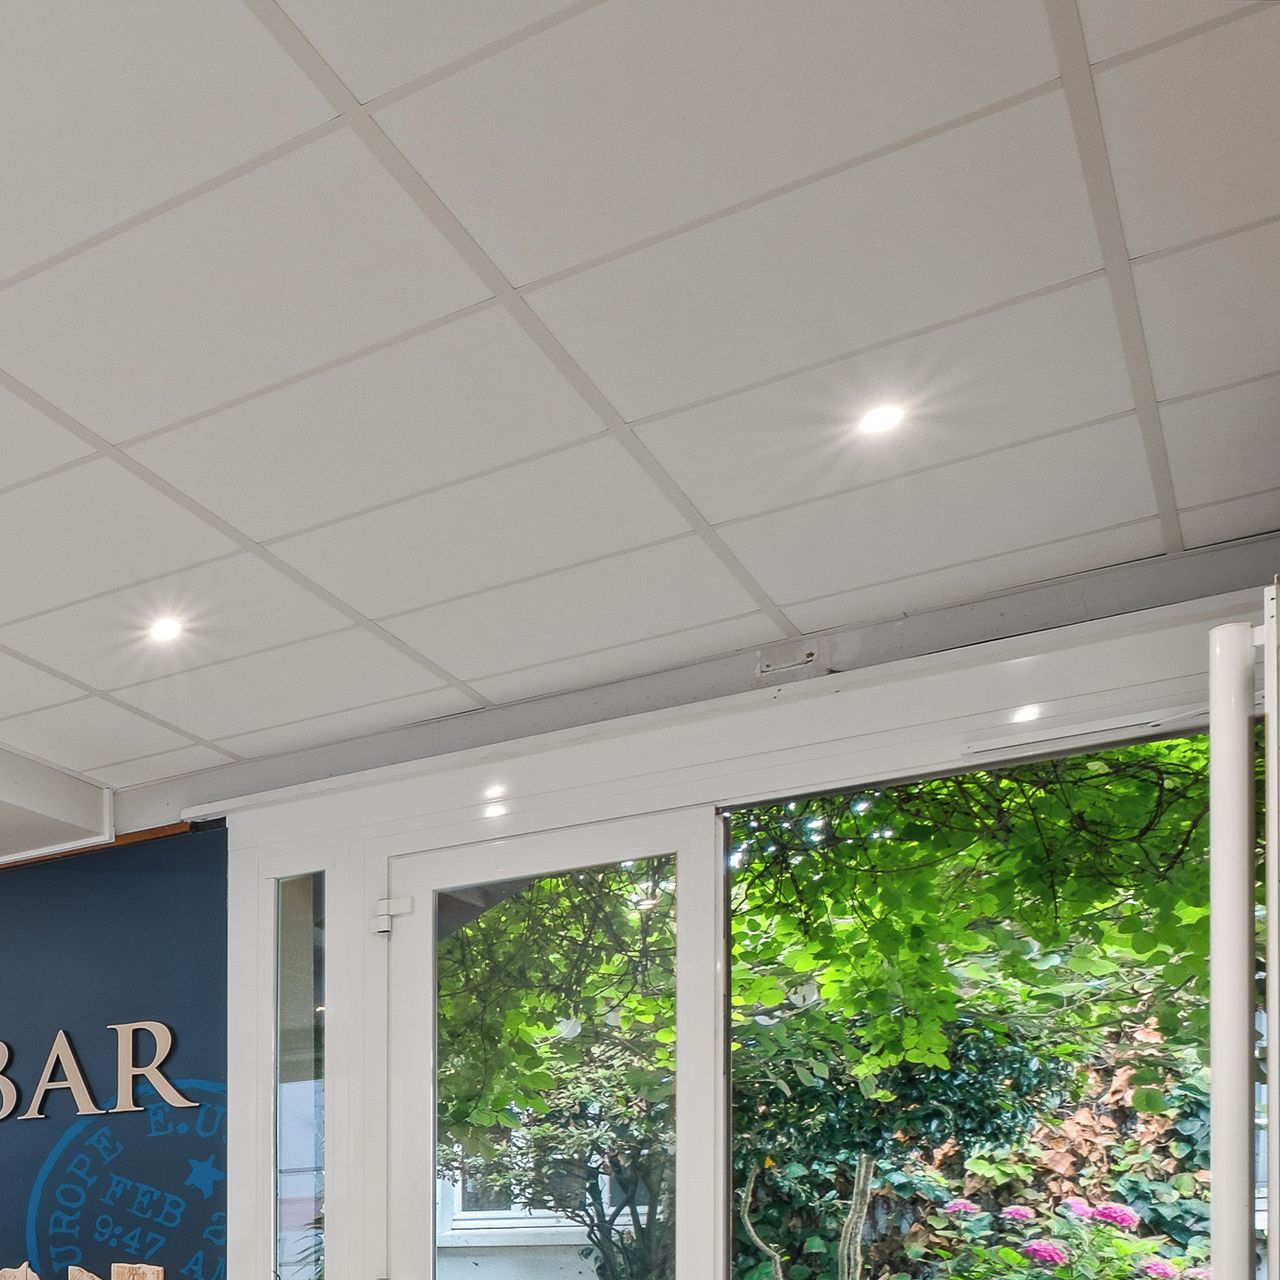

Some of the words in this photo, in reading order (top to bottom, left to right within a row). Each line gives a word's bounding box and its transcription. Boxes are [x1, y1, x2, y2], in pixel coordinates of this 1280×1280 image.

[48, 1125, 125, 1274] UROPE
[99, 1173, 188, 1228] FEB
[92, 1213, 167, 1261] 9:47
